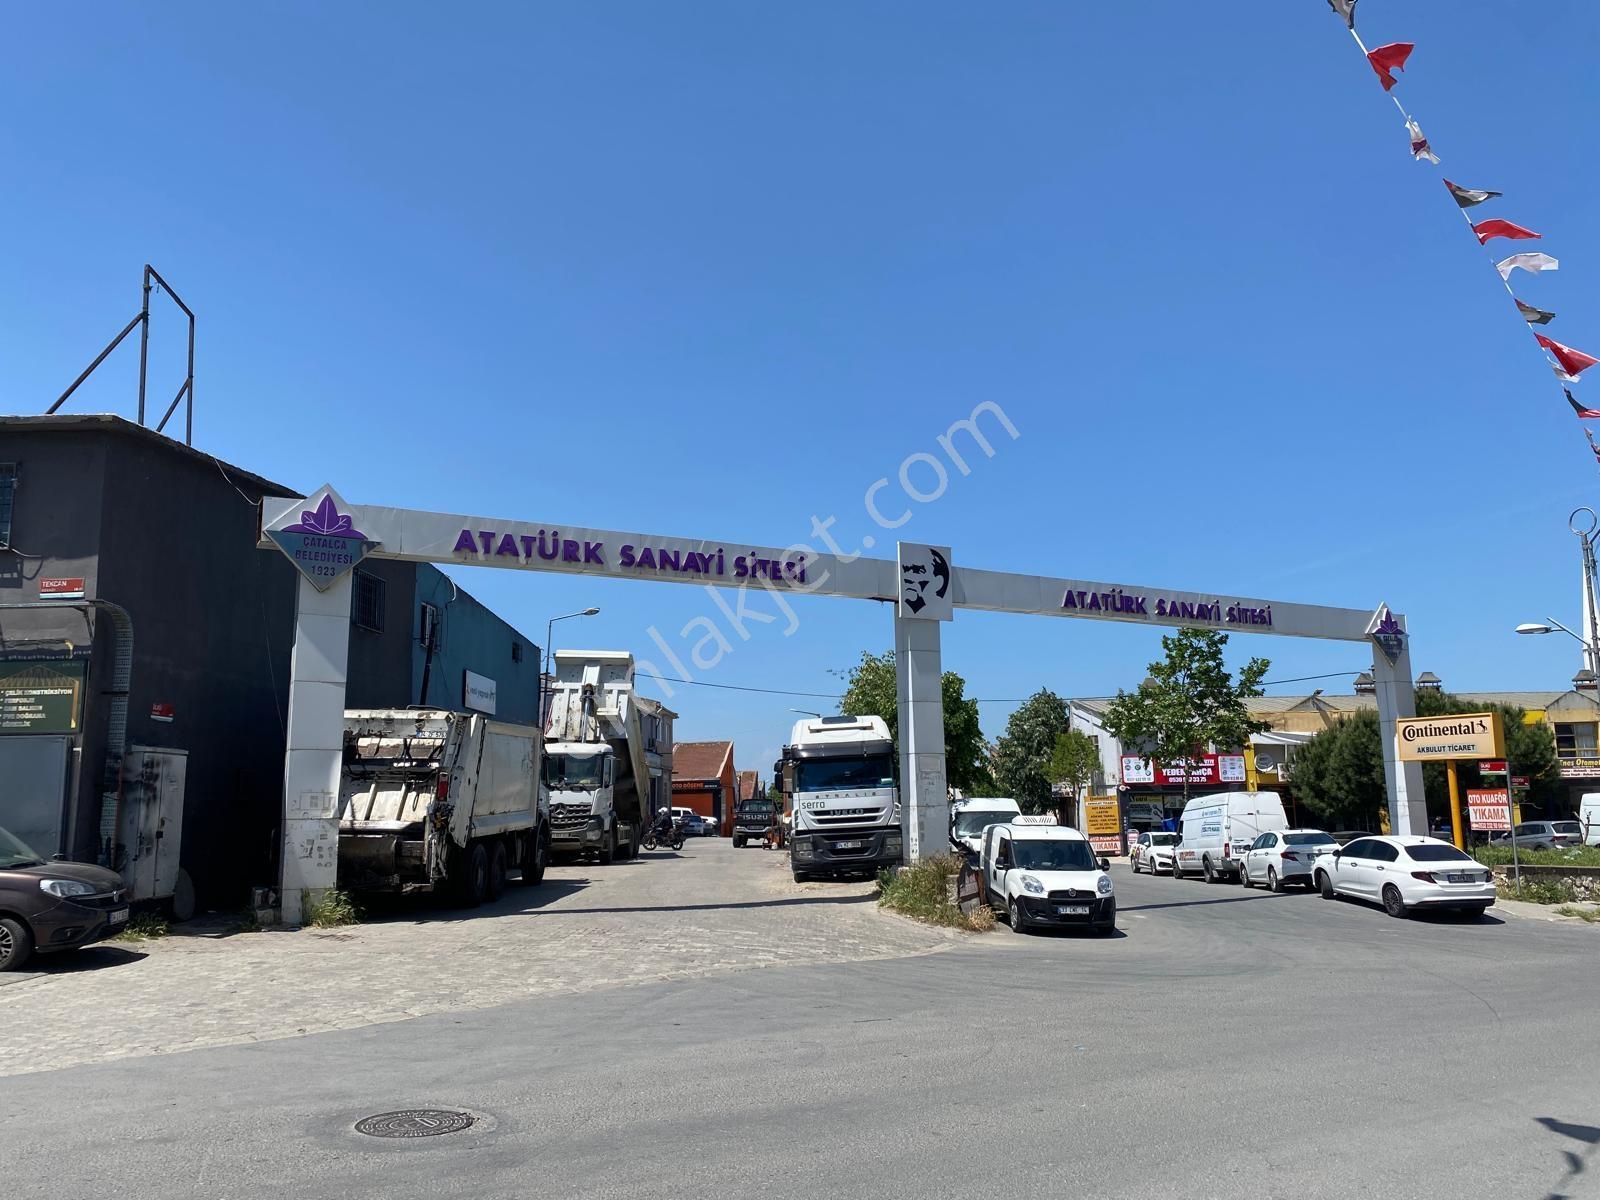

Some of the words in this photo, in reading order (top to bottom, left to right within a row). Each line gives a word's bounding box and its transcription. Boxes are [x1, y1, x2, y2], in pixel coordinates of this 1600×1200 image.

[295, 549, 353, 565] BELEDİYESİ
[452, 528, 604, 565] ATATÜRK
[619, 545, 724, 576] SANAYİ
[733, 551, 806, 583] SİTESİ
[311, 565, 336, 577] 1923
[1062, 588, 1147, 615] ATATÜRK
[1154, 598, 1221, 622] SANAYİ
[1226, 601, 1273, 626] SİTESİ
[1402, 721, 1475, 742] Continental
[1417, 745, 1446, 754] AKBULUT
[1447, 744, 1476, 752] TİCARET
[1468, 794, 1481, 804] OTO
[1481, 792, 1508, 804] KUAFÖR
[829, 808, 864, 816] IVECO
[1472, 808, 1506, 820] YIKAMA
